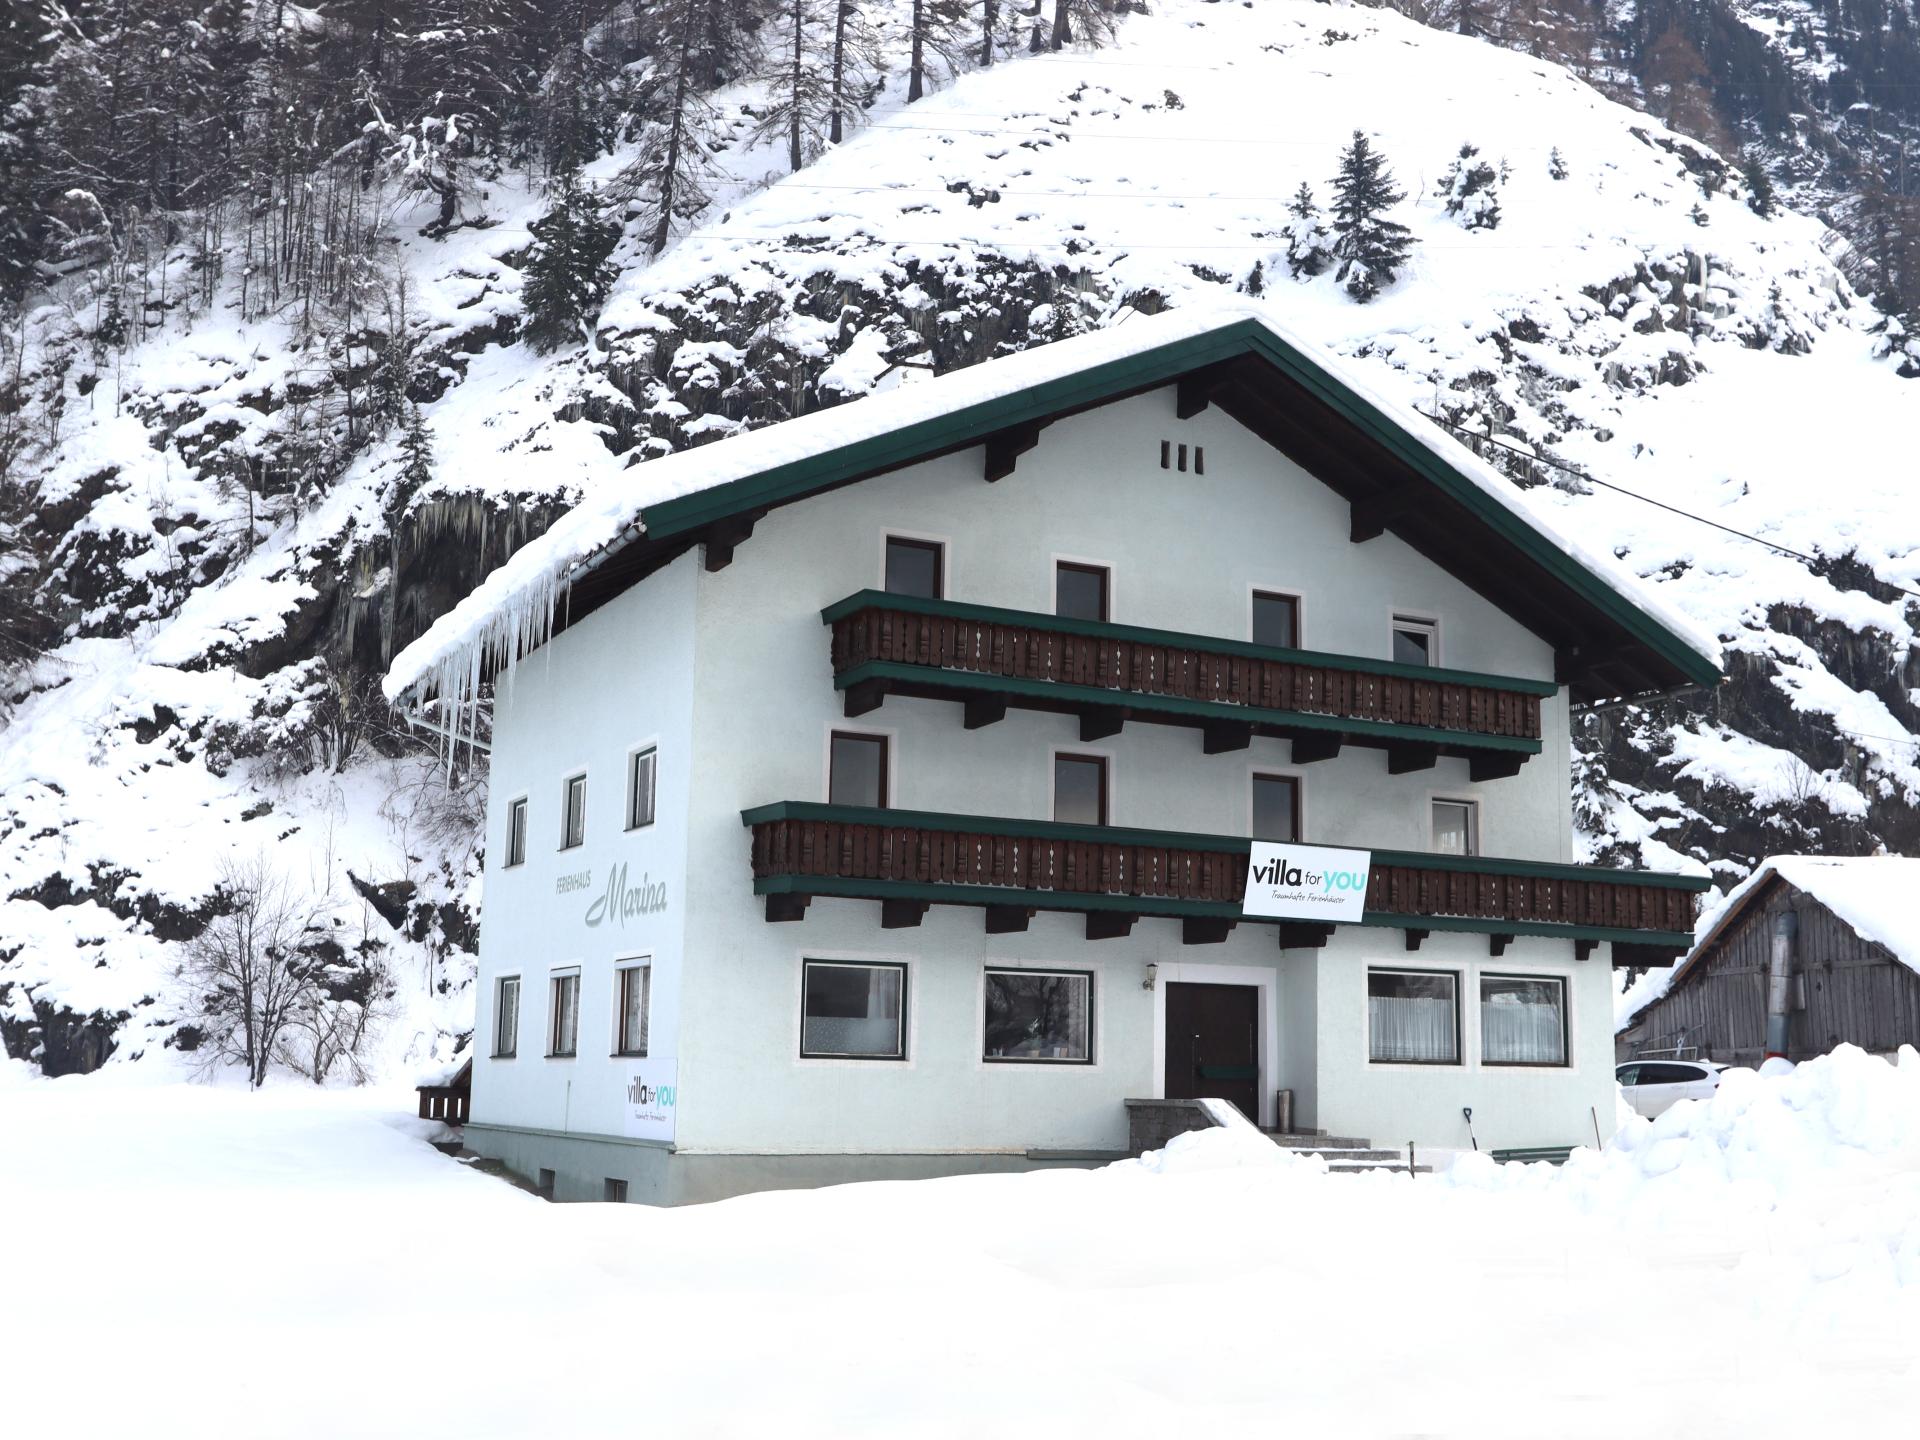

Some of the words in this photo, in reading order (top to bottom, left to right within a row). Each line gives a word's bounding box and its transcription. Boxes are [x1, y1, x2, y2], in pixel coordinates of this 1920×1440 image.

[1252, 858, 1302, 887] villa
[1305, 871, 1322, 886] for
[1323, 869, 1365, 893] you
[555, 869, 591, 895] FERIENHAUS
[585, 860, 668, 930] Marina
[1271, 889, 1306, 902] Traumhafte
[627, 1075, 648, 1105] villa
[648, 1087, 656, 1102] for
[656, 1085, 676, 1110] you
